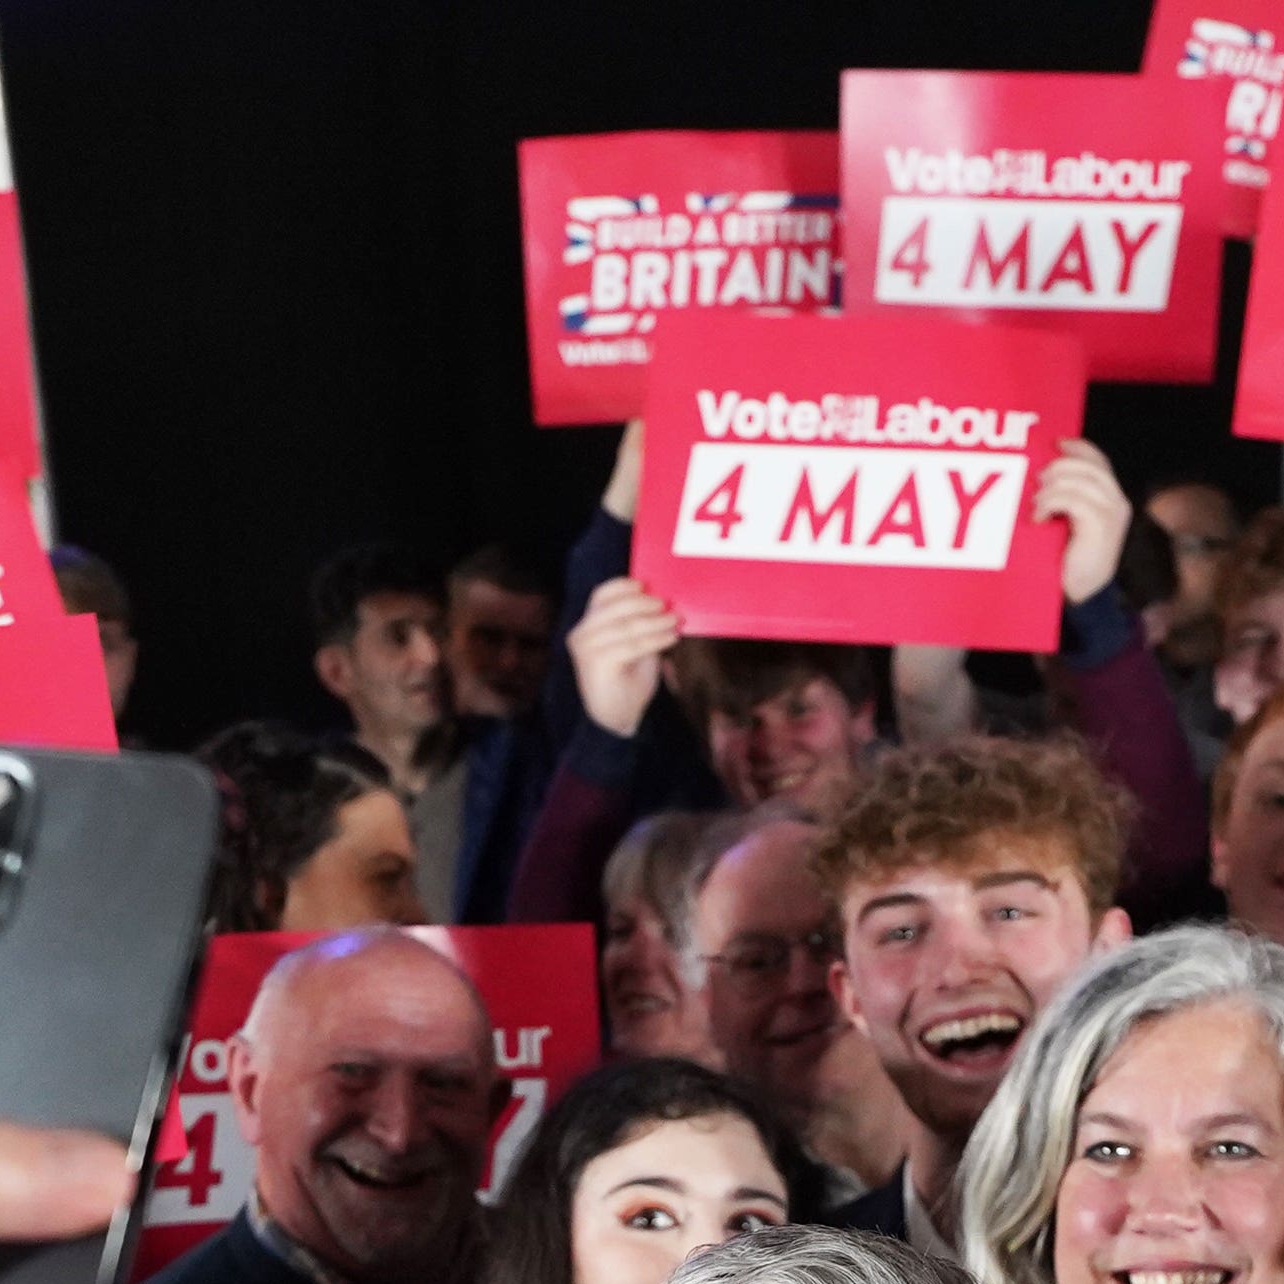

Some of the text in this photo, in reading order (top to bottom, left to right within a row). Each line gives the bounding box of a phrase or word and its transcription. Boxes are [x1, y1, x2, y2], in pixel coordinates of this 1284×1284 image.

[886, 148, 993, 196] Vote
[1031, 150, 1189, 198] Labour
[595, 211, 835, 250] BUILD A BETTER
[889, 218, 1159, 294] 4 MAY
[590, 246, 831, 312] BRITAIN
[696, 389, 1041, 450] Vote Labour
[691, 460, 1005, 552] 4 MAY
[155, 1110, 222, 1206] 4
